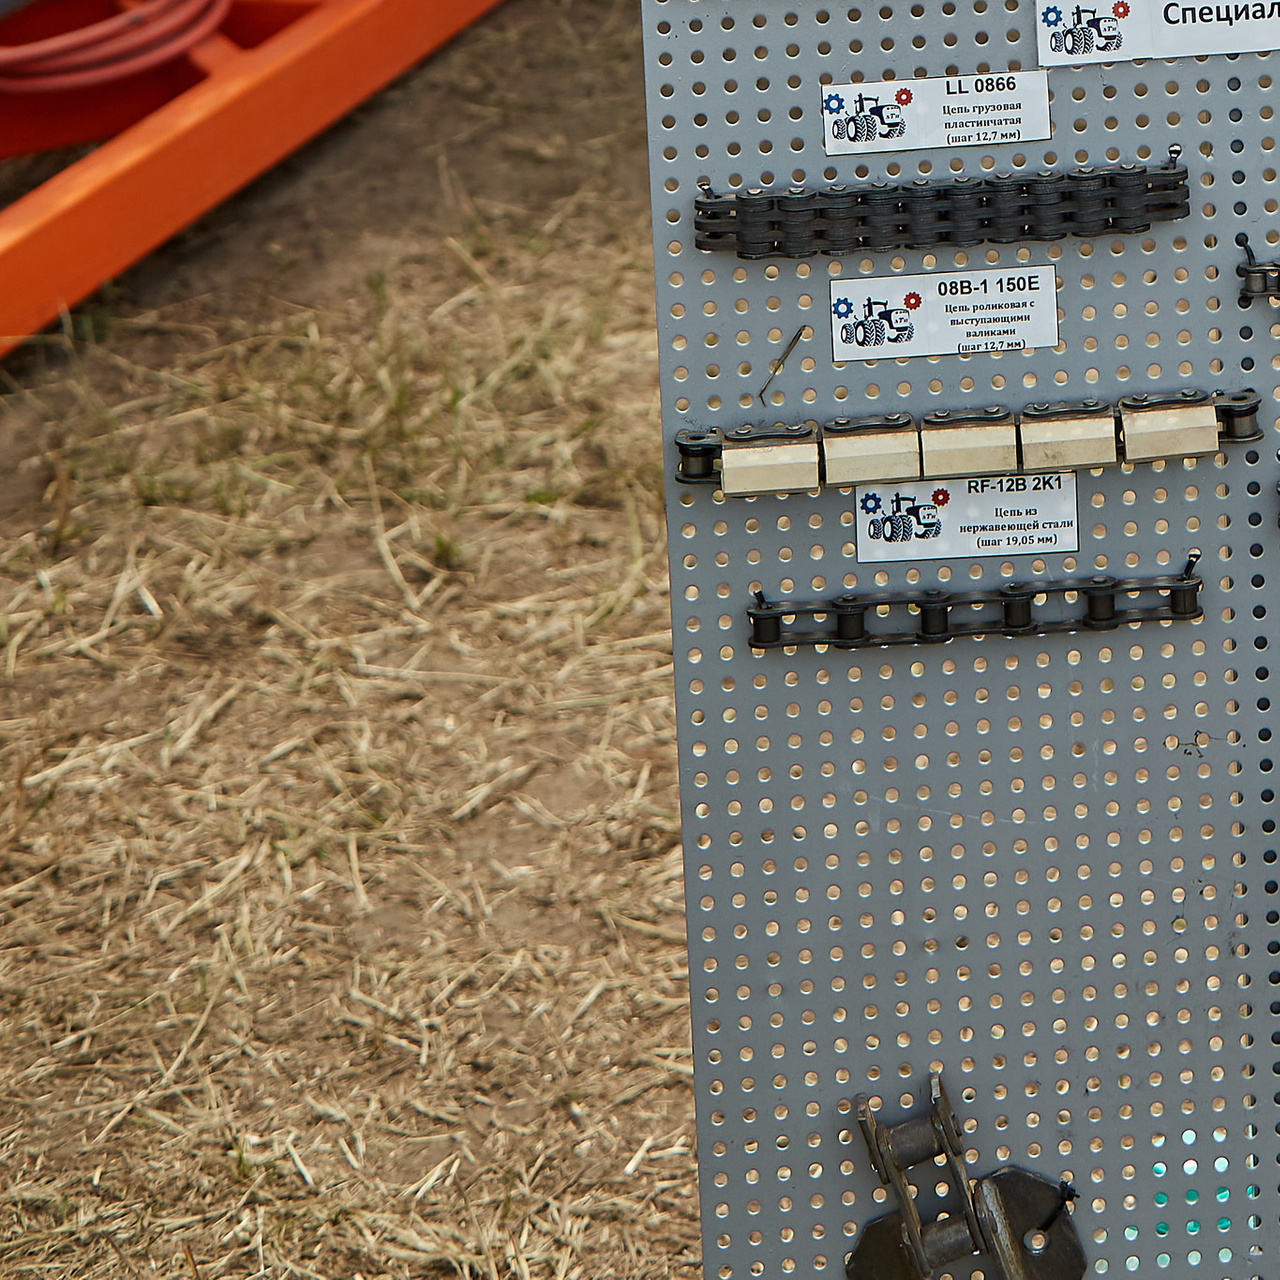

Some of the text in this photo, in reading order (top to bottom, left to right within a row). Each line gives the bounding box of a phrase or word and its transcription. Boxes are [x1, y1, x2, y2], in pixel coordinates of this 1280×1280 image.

[946, 76, 1016, 95] LL 0866
[943, 103, 1022, 116] Цепь грузовая
[944, 117, 1021, 129] пластинчатая
[947, 129, 1021, 145] (шаг 12,7 мм)
[938, 275, 1040, 296] 08B-1 150E
[945, 304, 970, 314] Цепь
[972, 301, 1027, 313] роликовая
[950, 314, 1030, 327] выступающими
[966, 328, 1016, 338] валиками
[957, 340, 1026, 354] (шаг 12,7 мм)
[967, 475, 1062, 494] RF-12B 2K1
[995, 507, 1037, 518] Цепь из
[960, 520, 1073, 535] нержавеющей стали
[977, 533, 1057, 549] (шаг 19,05 мм)
